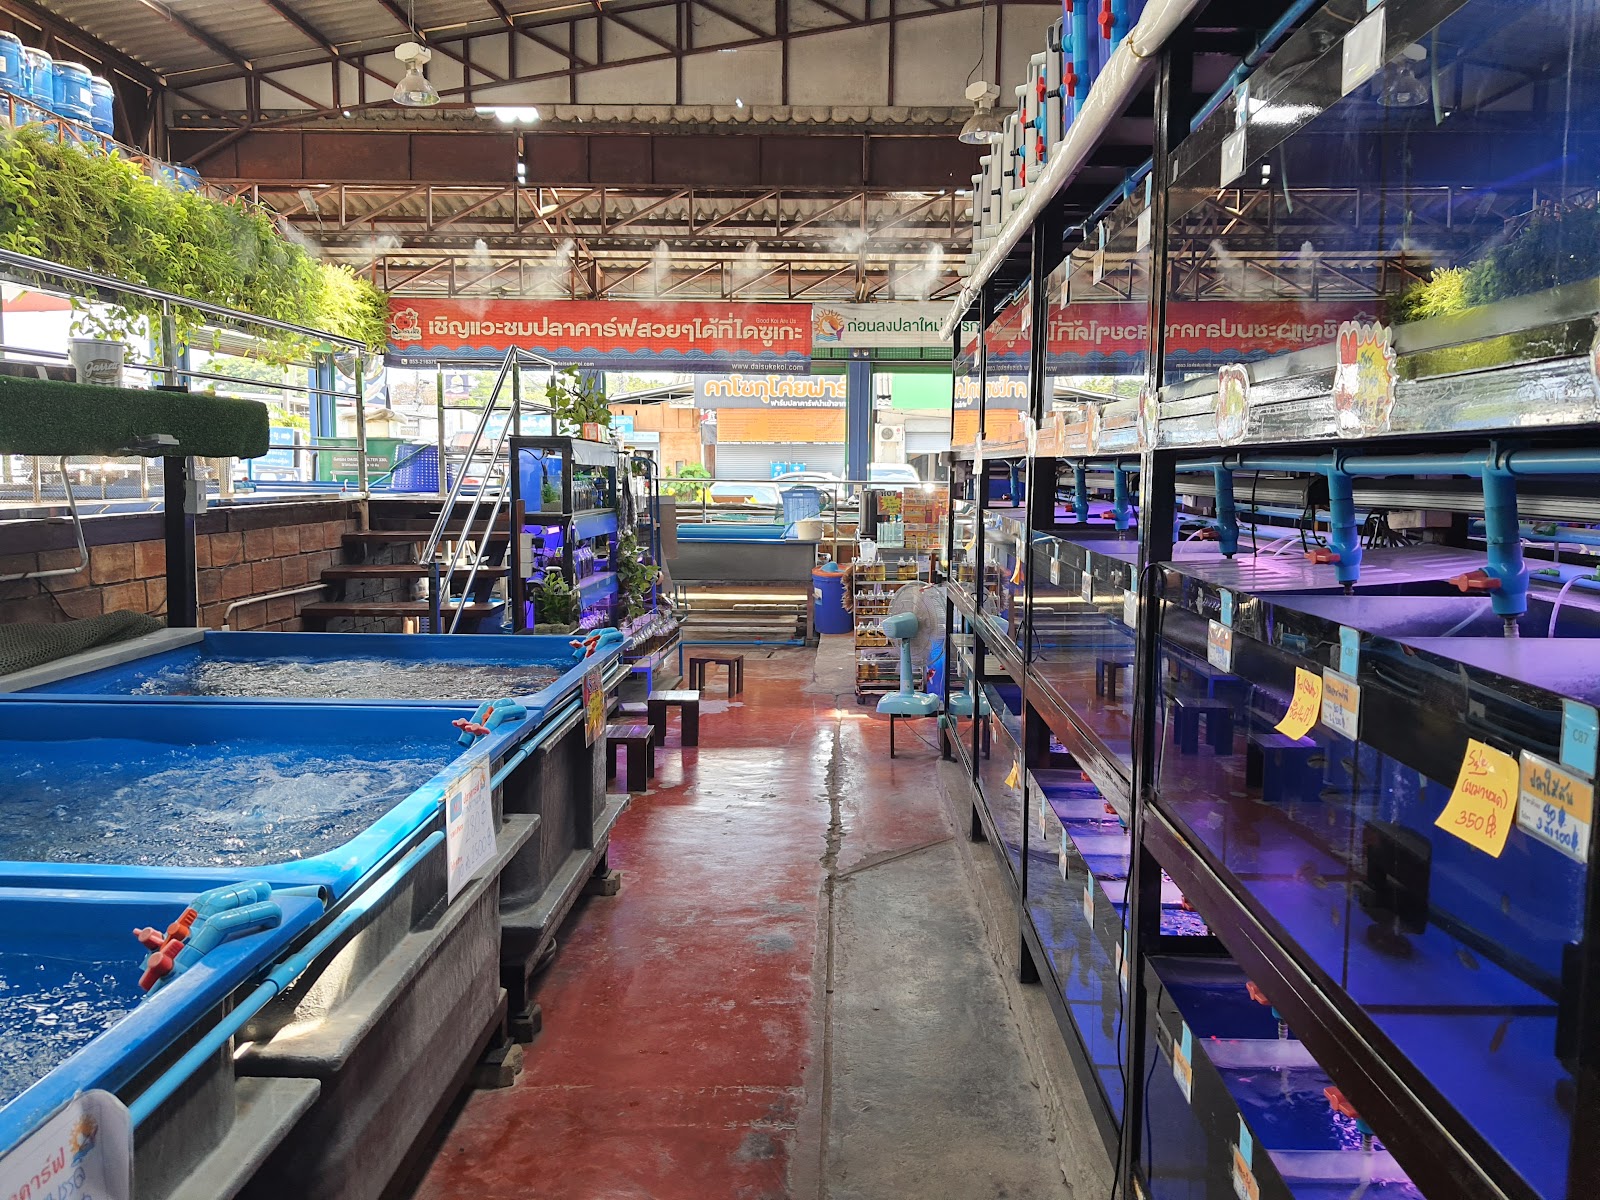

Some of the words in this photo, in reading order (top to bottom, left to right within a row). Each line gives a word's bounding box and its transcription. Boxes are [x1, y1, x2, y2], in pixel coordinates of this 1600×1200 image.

[428, 313, 803, 346] เชิญแวะชมปลาคาร์ฟสวยๆได้ที่ไดซูเกะ
[755, 317, 770, 325] Good
[731, 362, 804, 372] www.daisukekoi.com
[1572, 728, 1589, 745] C87
[1467, 749, 1489, 771] Sale
